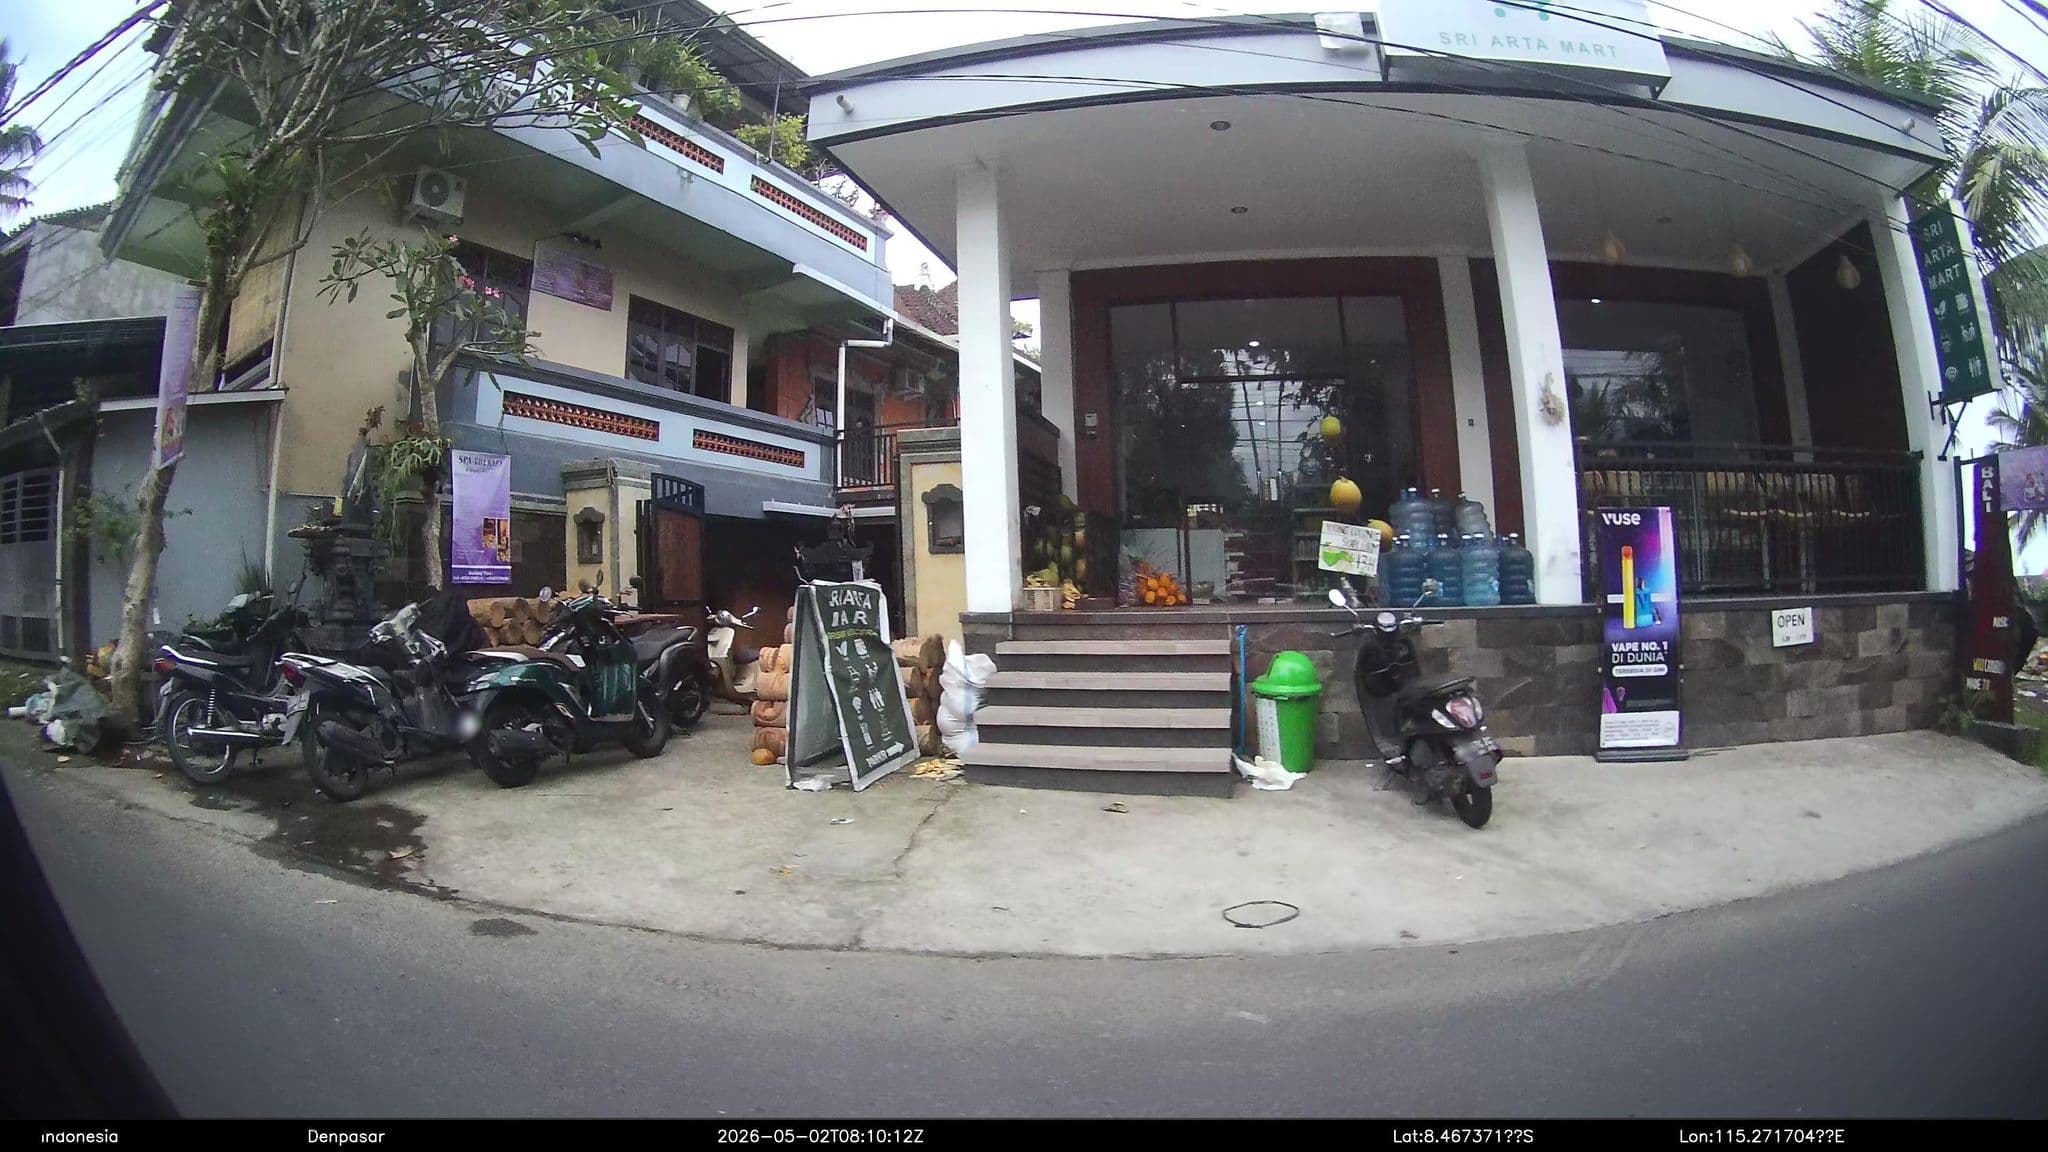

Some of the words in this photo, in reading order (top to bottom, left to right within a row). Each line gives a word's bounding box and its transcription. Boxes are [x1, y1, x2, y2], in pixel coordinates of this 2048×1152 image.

[1439, 32, 1477, 47] SRI
[1491, 34, 1549, 51] ARTA
[1560, 40, 1617, 58] MART
[1923, 221, 1943, 241] SRI
[1924, 242, 1955, 266] ARTA
[1928, 264, 1960, 290] MART
[1981, 466, 1994, 513] BALI
[1777, 614, 1805, 628] OPEN
[1612, 642, 1639, 652] VAPE
[1641, 641, 1661, 651] NO.
[1662, 641, 1668, 651] 1
[1611, 653, 1624, 664] DI
[1627, 652, 1664, 663] DUNIA
